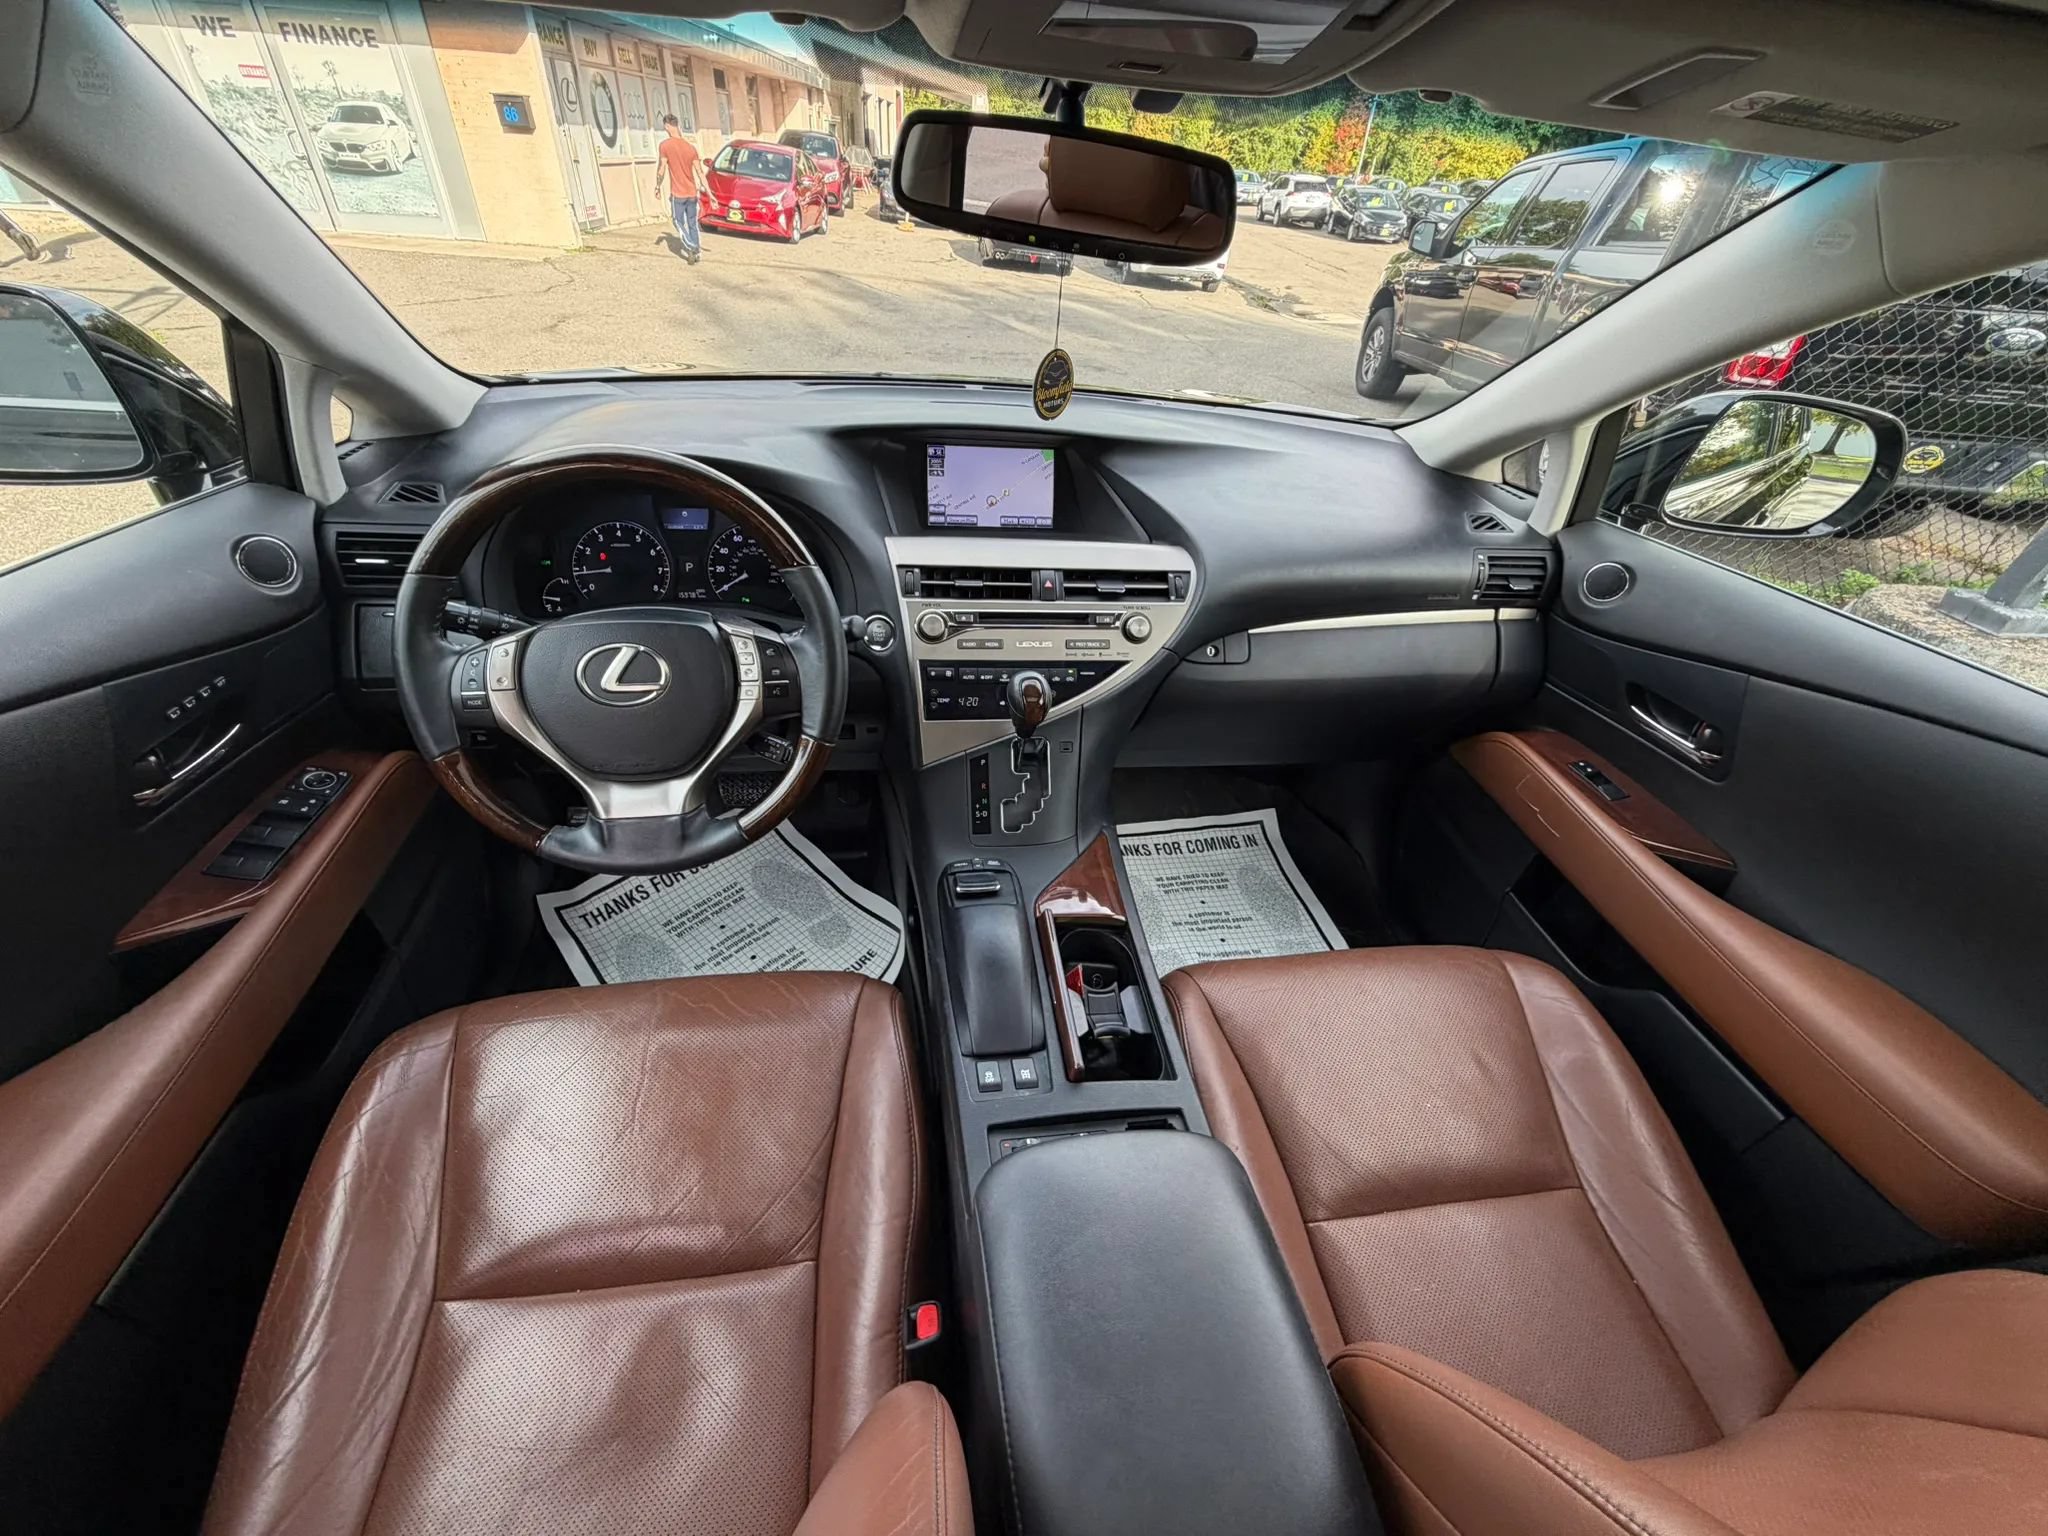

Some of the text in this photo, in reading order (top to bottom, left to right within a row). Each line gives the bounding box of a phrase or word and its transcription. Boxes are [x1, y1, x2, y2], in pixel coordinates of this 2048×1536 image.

[192, 14, 380, 48] WE FINANCE
[584, 38, 598, 57] BUY
[618, 46, 632, 64] SELL
[504, 105, 518, 122] 86
[686, 562, 694, 572] P
[1154, 842, 1183, 856] FOR
[1186, 835, 1240, 854] COMING
[1242, 834, 1258, 848] IN
[579, 884, 650, 928] THANKS
[662, 920, 673, 928] WE
[674, 908, 693, 921] HAVE
[692, 897, 713, 910] TRIED
[722, 882, 738, 893] KEEP
[666, 887, 744, 934] YOUR CARPETING CLEAN
[675, 894, 746, 938] WITH THIS PAPER MAT
[707, 949, 725, 962] most
[725, 929, 758, 951] important
[717, 928, 747, 947] customer
[734, 940, 754, 954] world
